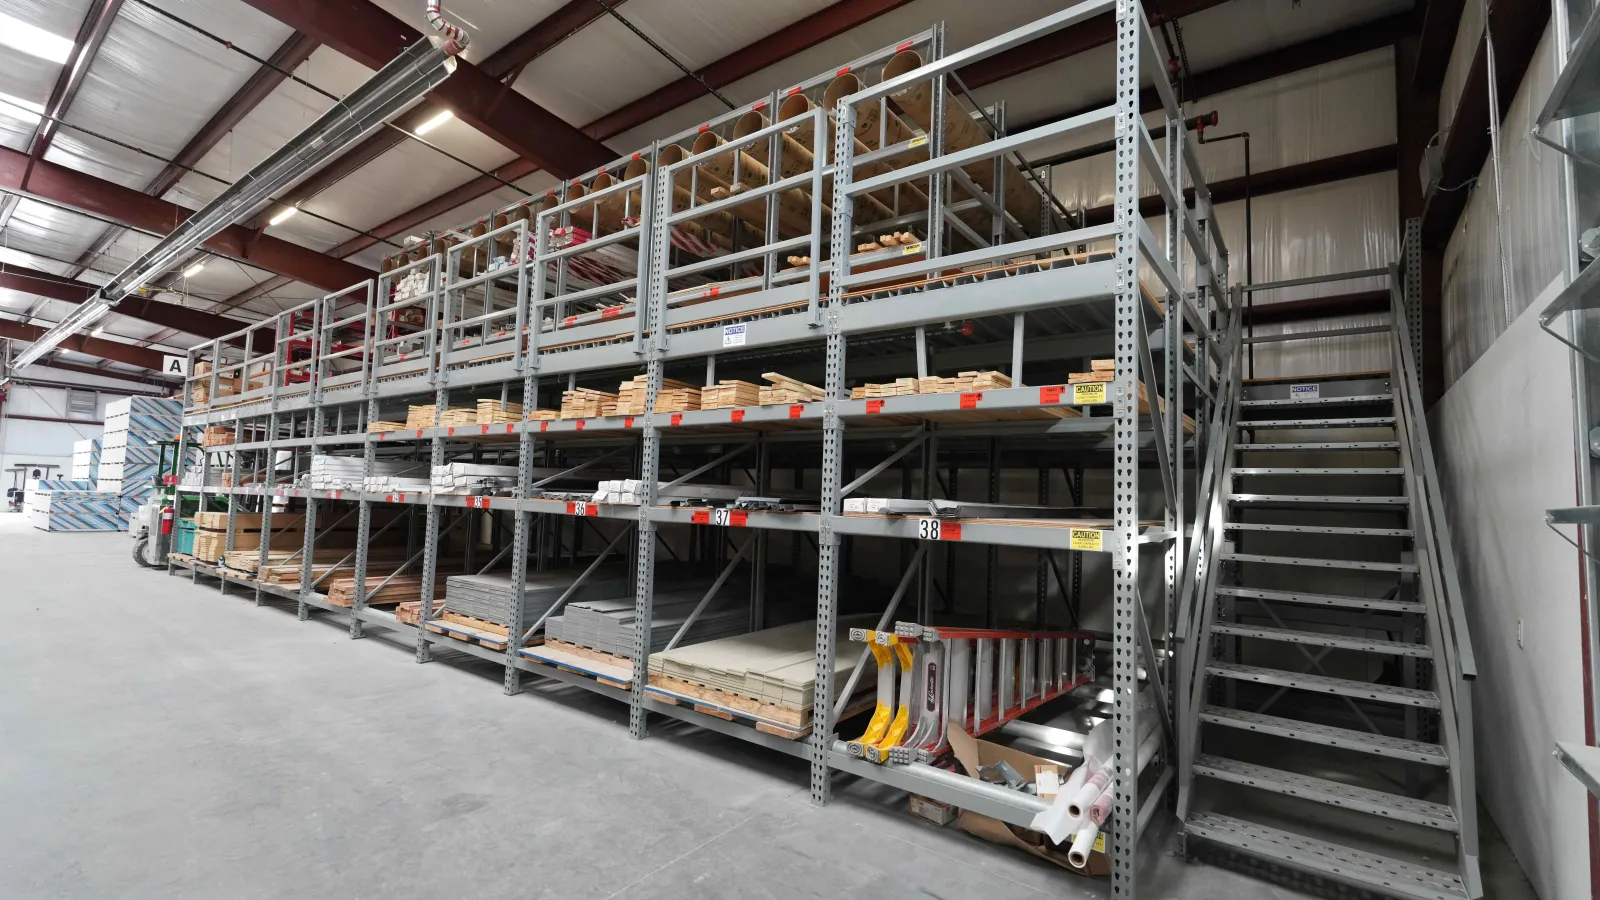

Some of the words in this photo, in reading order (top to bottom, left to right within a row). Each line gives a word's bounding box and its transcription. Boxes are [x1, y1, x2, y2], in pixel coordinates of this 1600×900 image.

[725, 326, 745, 335] NOTICE
[169, 359, 182, 373] A
[1076, 385, 1103, 393] CAUTION
[475, 496, 482, 508] 35
[576, 503, 585, 516] 36
[716, 509, 729, 526] 37
[920, 519, 939, 540] 38
[1072, 531, 1100, 539] CAUTION
